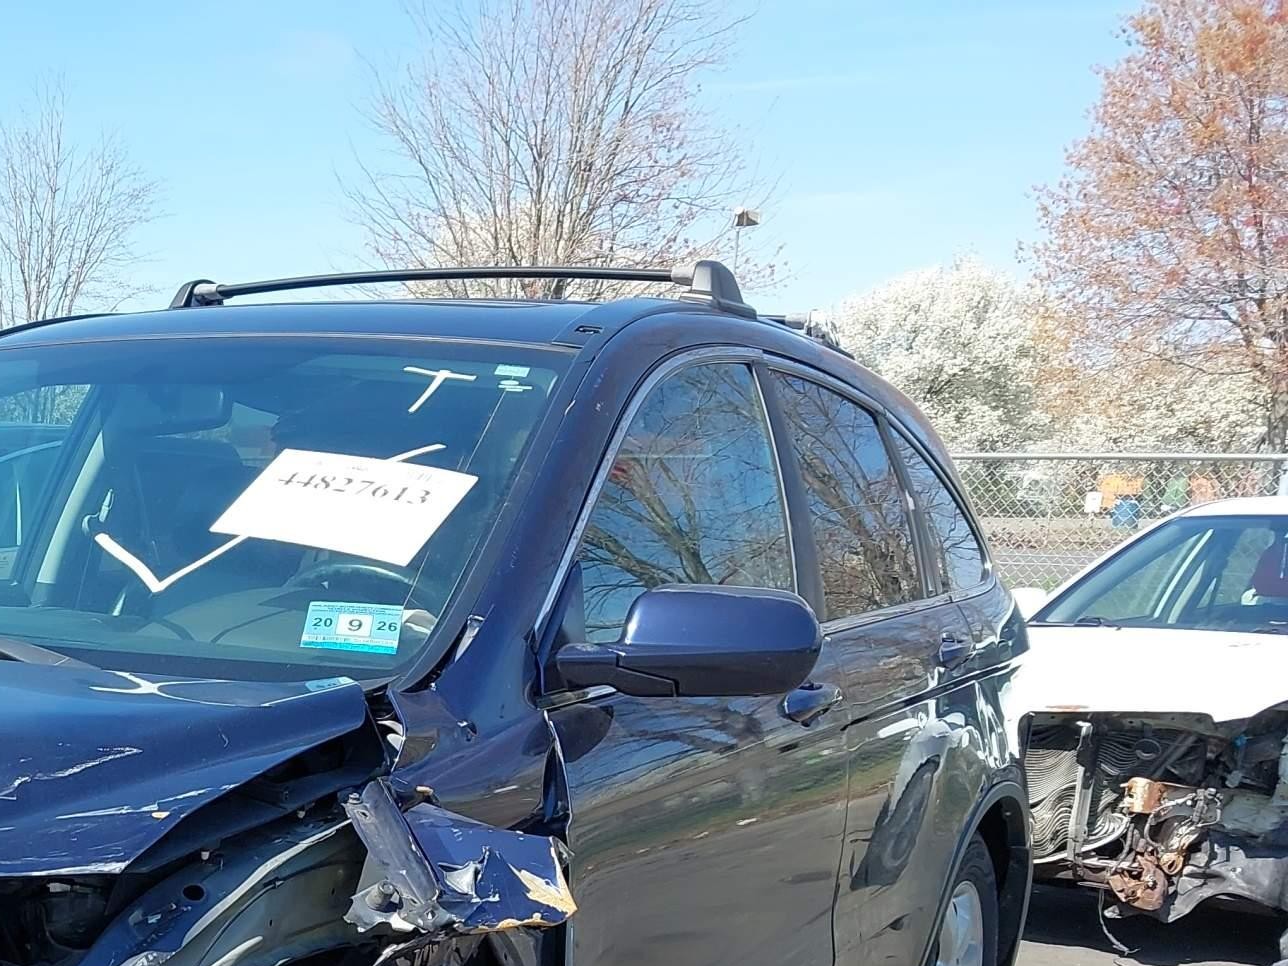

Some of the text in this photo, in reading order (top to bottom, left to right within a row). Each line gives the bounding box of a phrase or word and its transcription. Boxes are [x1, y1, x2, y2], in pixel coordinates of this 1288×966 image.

[278, 472, 431, 504] 44827613
[312, 617, 398, 632] 20 9 26
